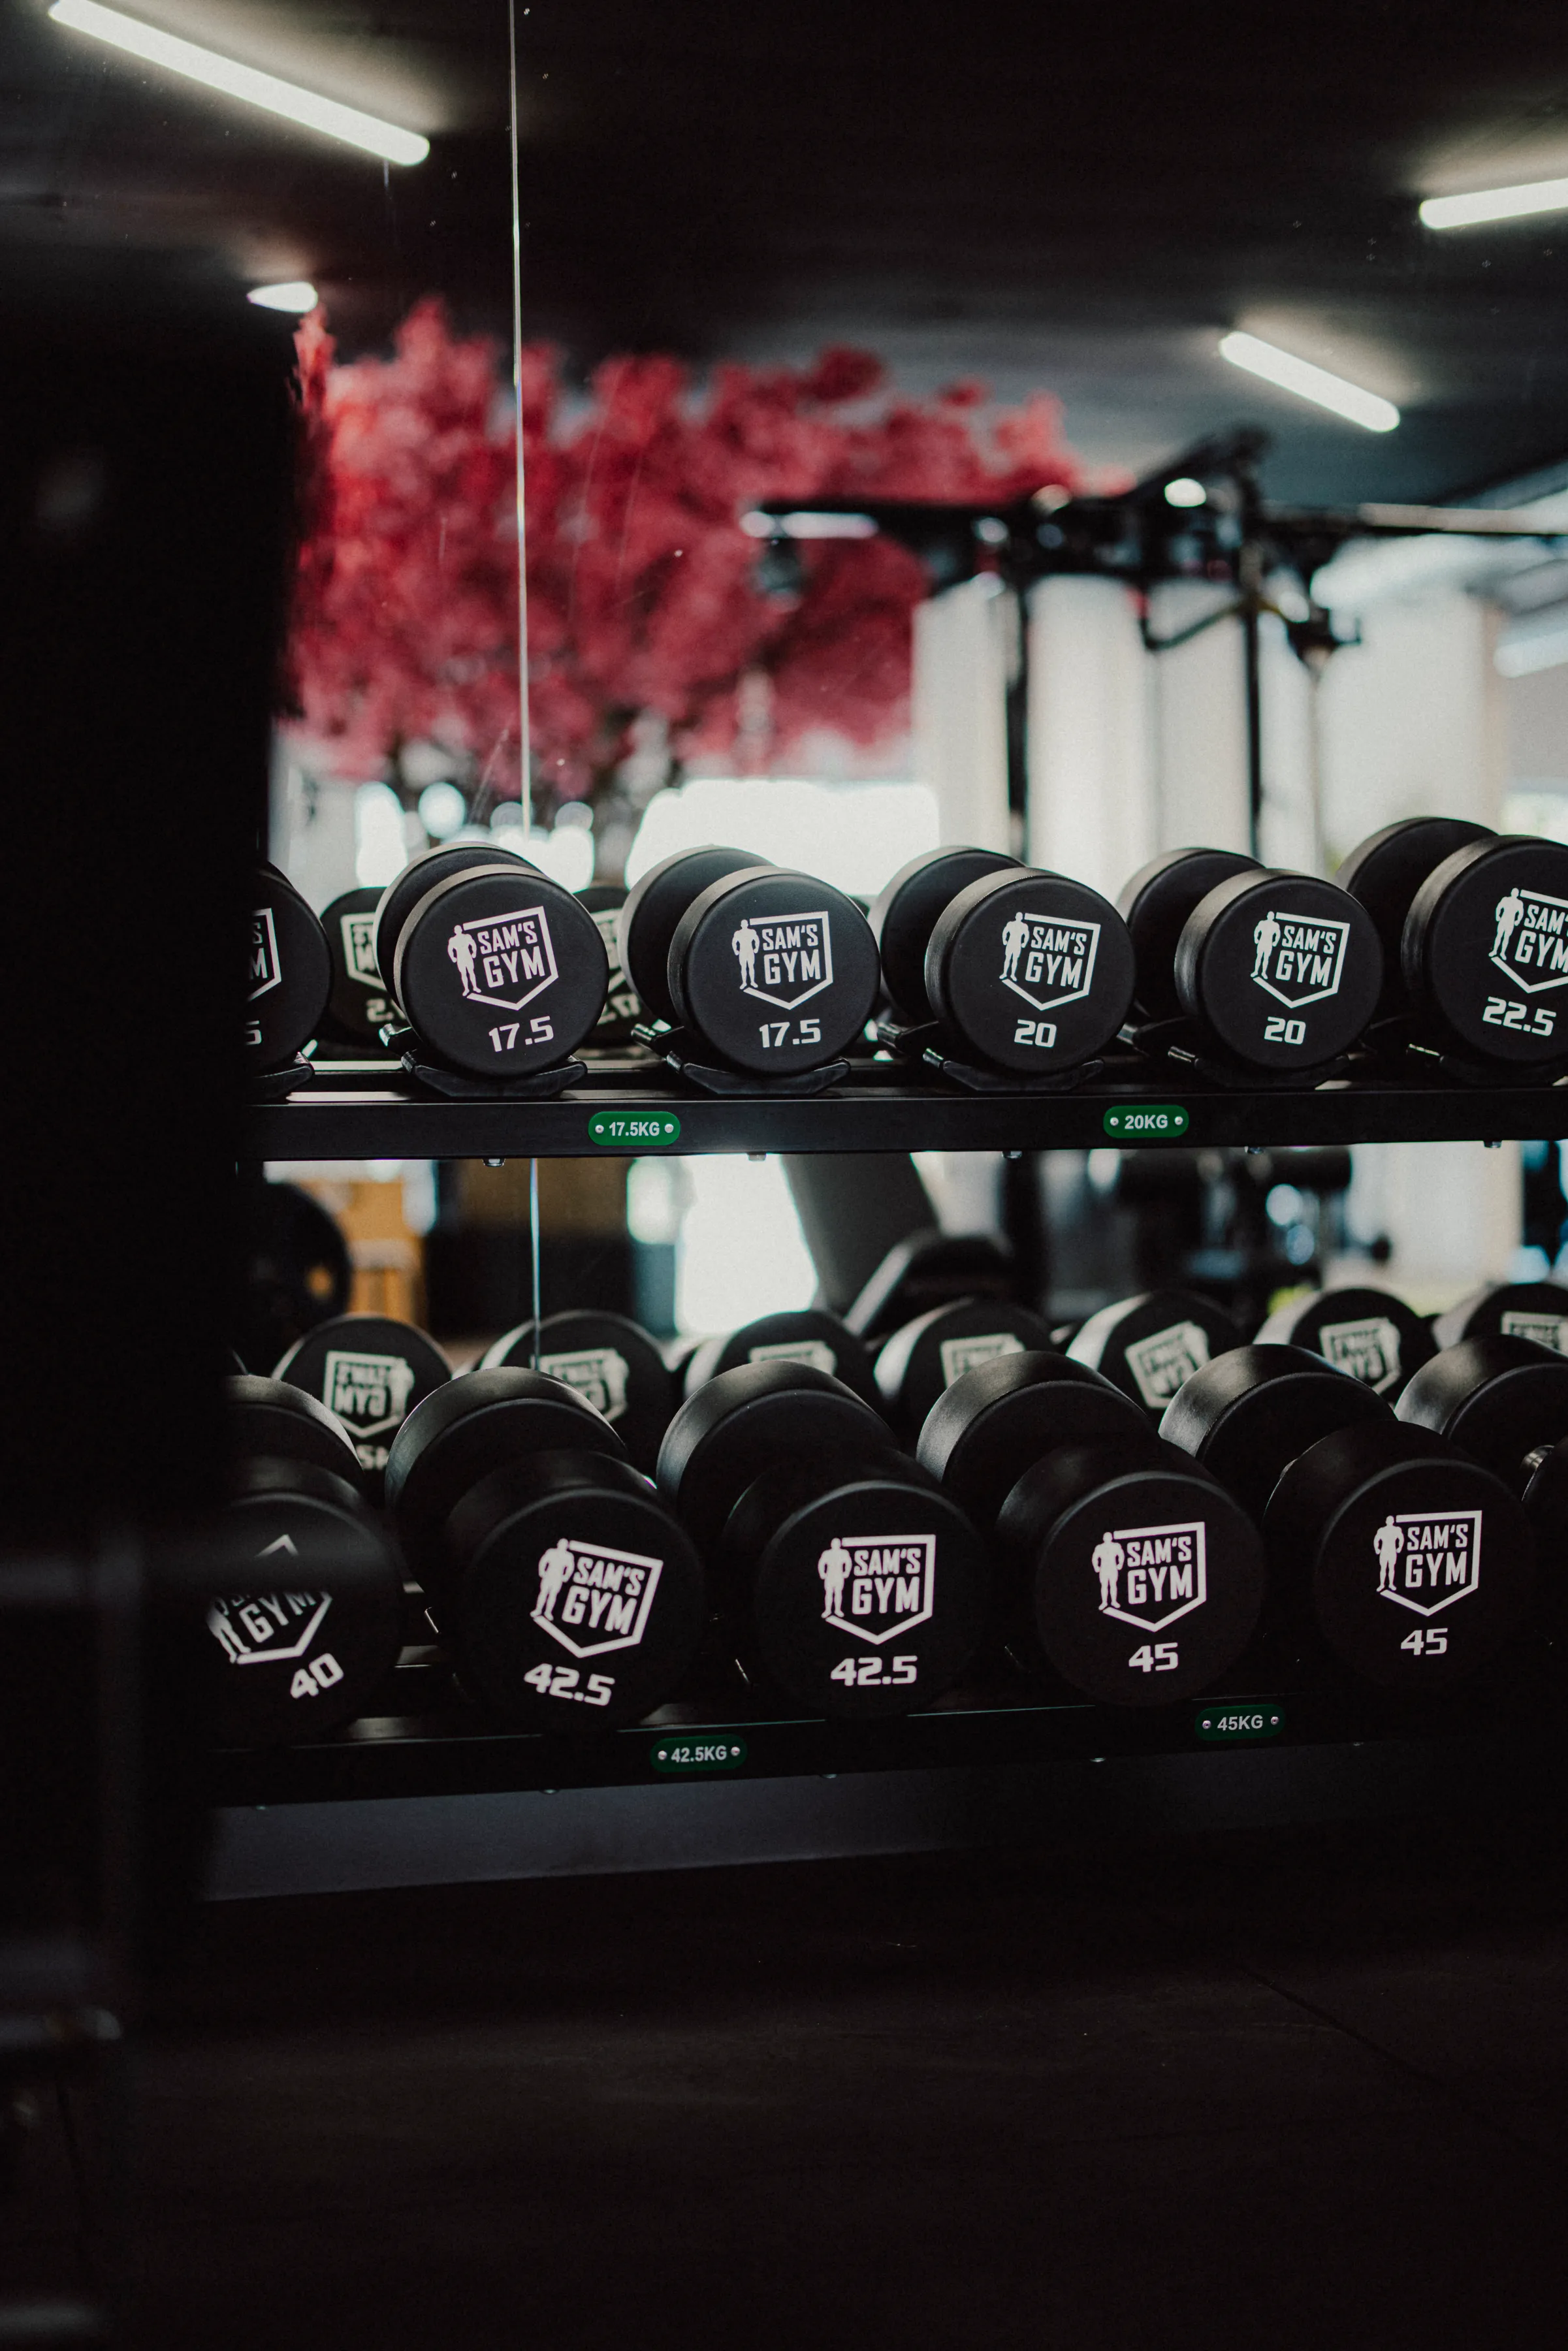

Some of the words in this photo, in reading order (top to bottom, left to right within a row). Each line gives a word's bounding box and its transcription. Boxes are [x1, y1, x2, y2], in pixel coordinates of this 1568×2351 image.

[1524, 904, 1568, 936] SAM'
[477, 921, 538, 954] SAM'S
[762, 924, 819, 951] SAM'S
[1031, 927, 1087, 955] SAM'S
[1282, 925, 1337, 953] SAM'S
[1515, 930, 1568, 973] GYM
[483, 946, 545, 987] GYM
[764, 950, 821, 984] GYM
[1025, 952, 1083, 988] GYM
[1276, 950, 1332, 986] GYM
[1264, 1017, 1306, 1045] 20
[1483, 997, 1557, 1036] 22.5
[489, 1016, 554, 1052] 17.5
[760, 1019, 821, 1048] 17.5
[1014, 1019, 1057, 1048] 20
[609, 1121, 660, 1136] 17.5KG
[1125, 1114, 1168, 1130] 20KG
[1127, 1536, 1191, 1567] SAM'S
[1407, 1524, 1468, 1550] SAM'S
[573, 1556, 645, 1596] SAM'S
[854, 1548, 921, 1576] SAM'S
[1405, 1552, 1467, 1588] GYM
[852, 1576, 920, 1615] GYM
[1127, 1564, 1192, 1605] GYM
[562, 1585, 637, 1634] GYM
[1129, 1642, 1179, 1672] 45
[1401, 1628, 1448, 1655] 45
[290, 1653, 344, 1699] 40
[524, 1663, 615, 1706] 42.5
[830, 1655, 918, 1686] 42.5
[1217, 1714, 1263, 1731] 45KG
[671, 1745, 727, 1763] 42.5KG
